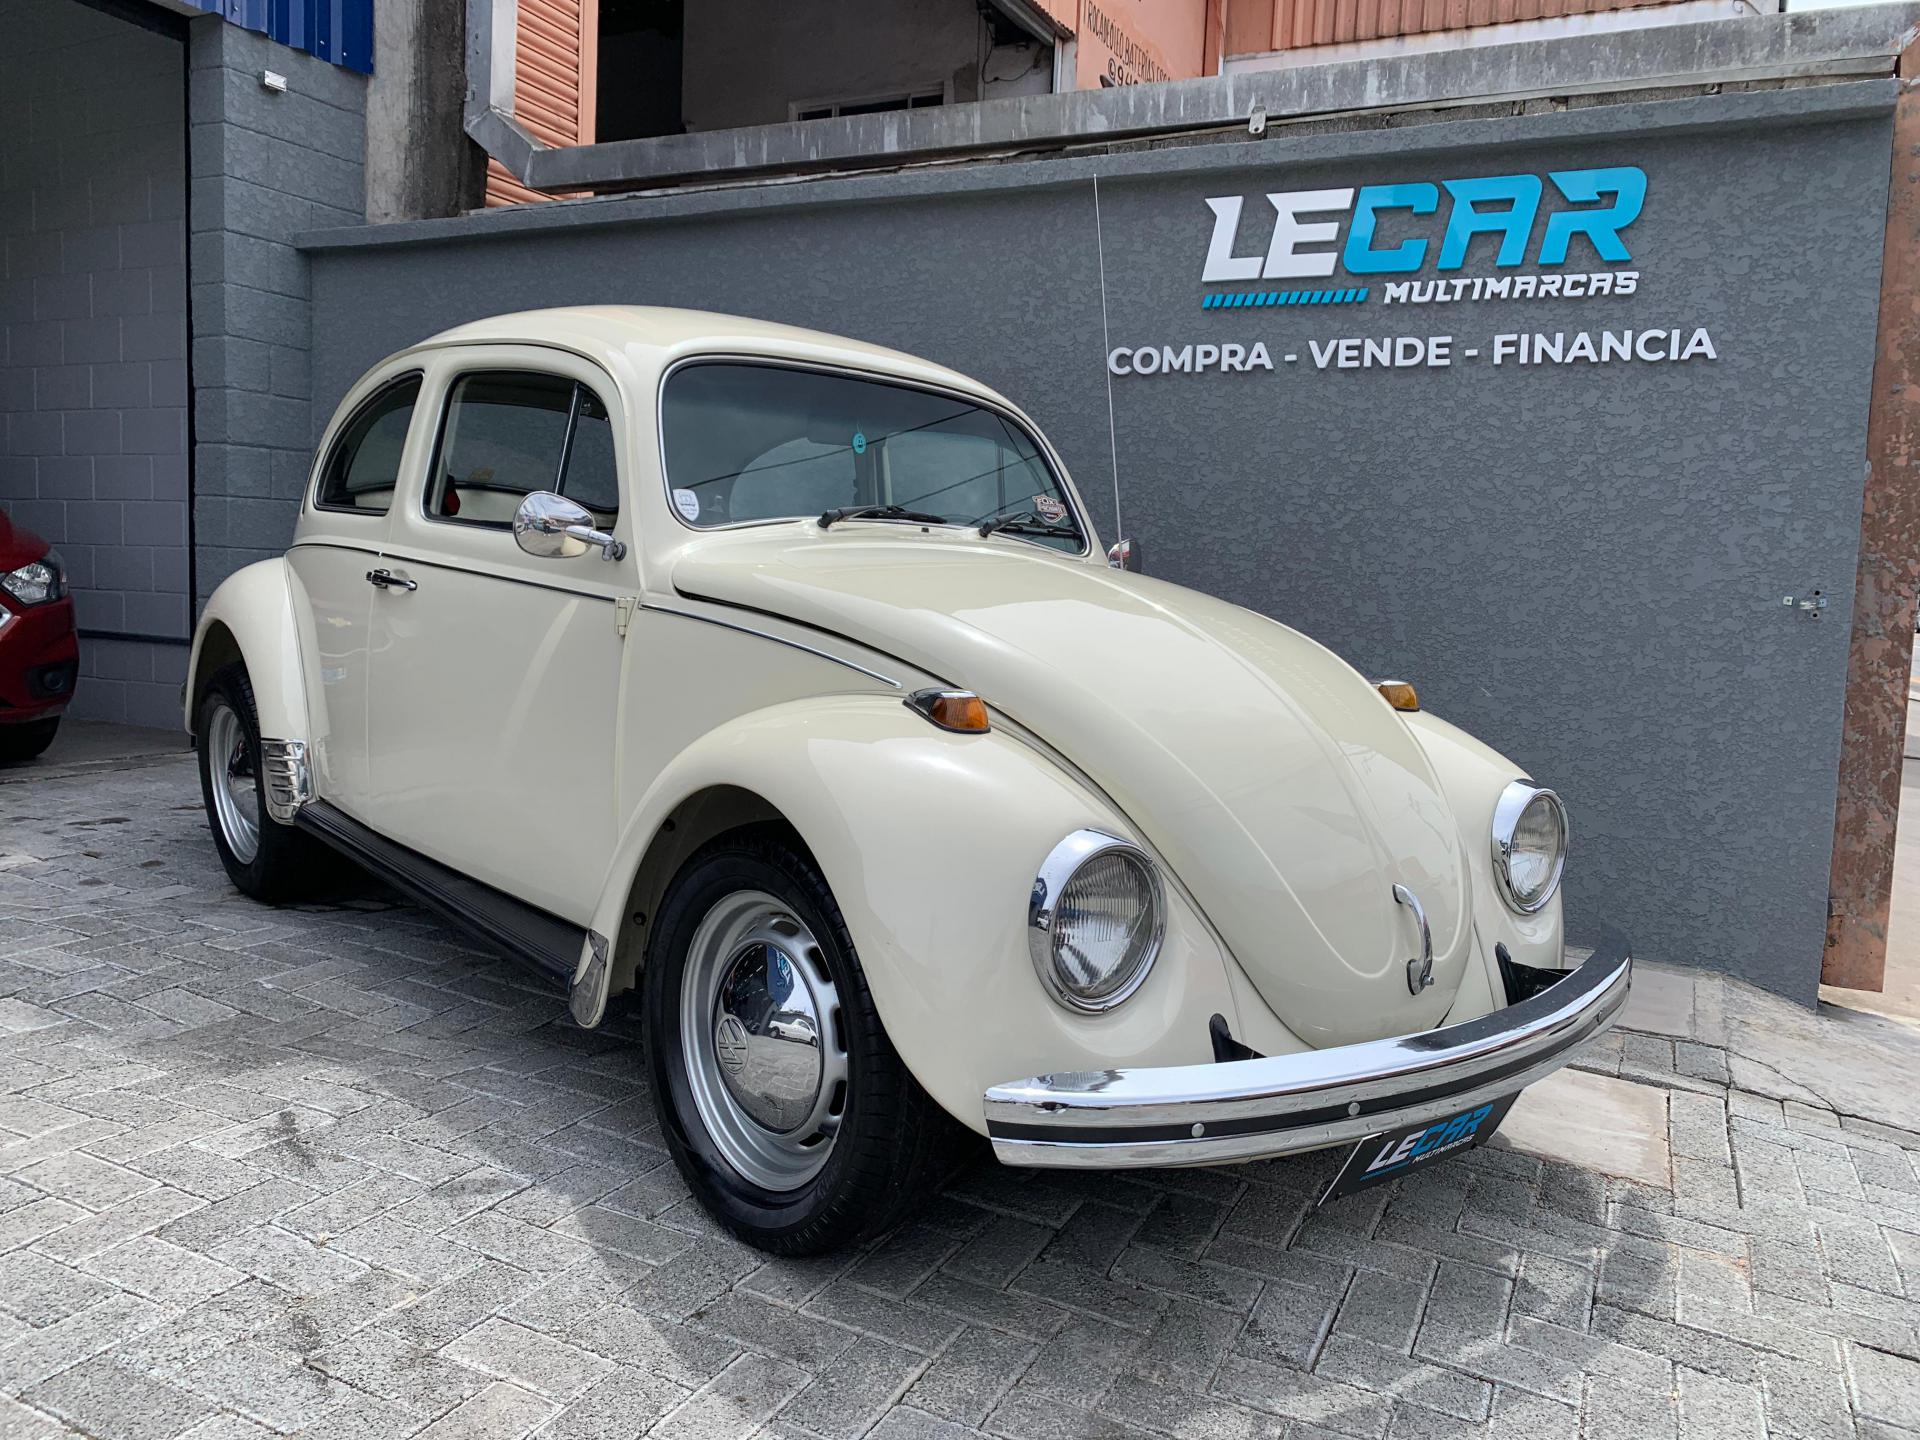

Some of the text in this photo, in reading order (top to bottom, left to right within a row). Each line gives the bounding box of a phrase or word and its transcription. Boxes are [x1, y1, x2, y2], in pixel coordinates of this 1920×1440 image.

[1202, 166, 1648, 282] LECAR
[1383, 271, 1640, 305] MULTIMARCAS
[1107, 342, 1274, 375] COMPRA
[1308, 336, 1453, 369] VENDE
[1493, 328, 1718, 365] FINANCIA
[1365, 1103, 1494, 1173] LECAR
